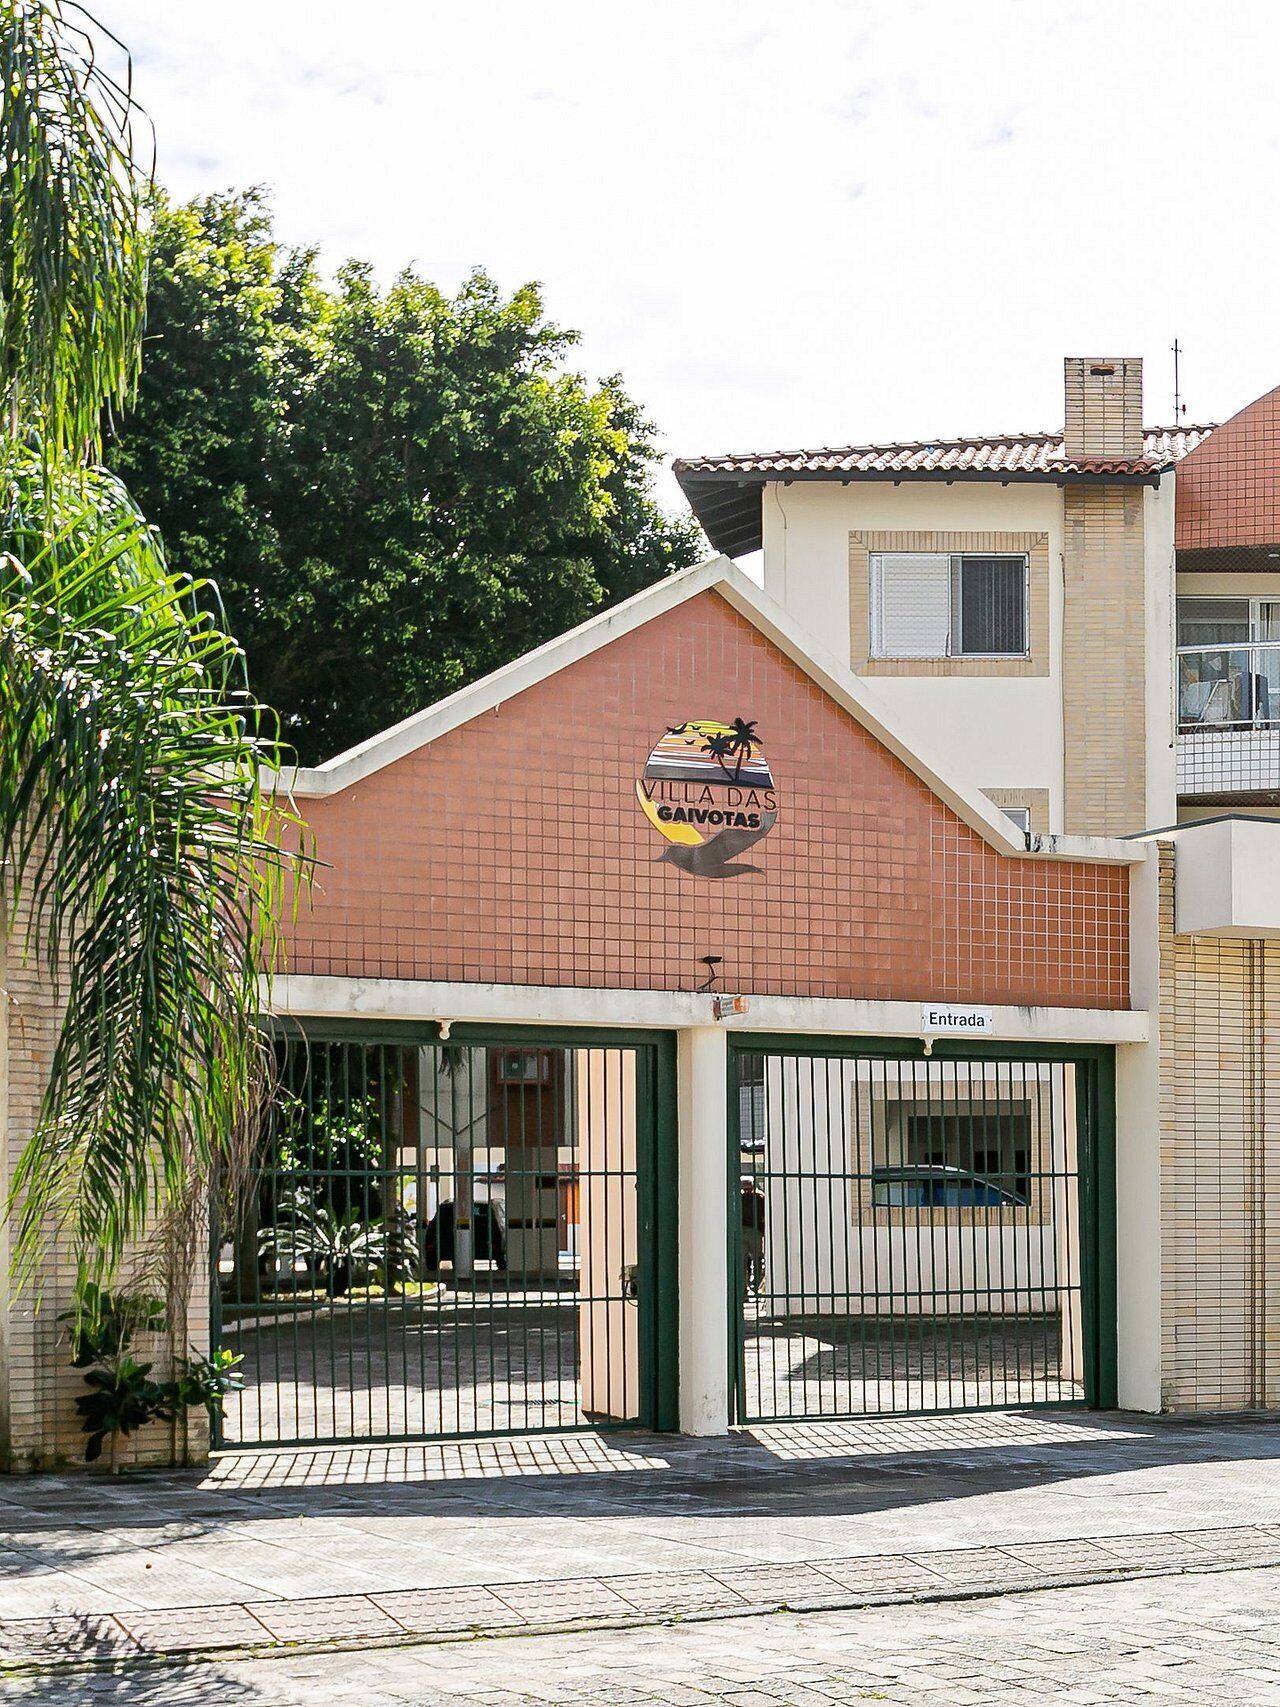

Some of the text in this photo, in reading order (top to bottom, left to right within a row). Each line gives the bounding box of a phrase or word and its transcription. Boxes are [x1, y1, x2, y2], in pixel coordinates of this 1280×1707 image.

[642, 779, 777, 810] VILLA DAS
[657, 805, 761, 828] GAIVOTAS
[929, 1011, 985, 1027] Entrada
